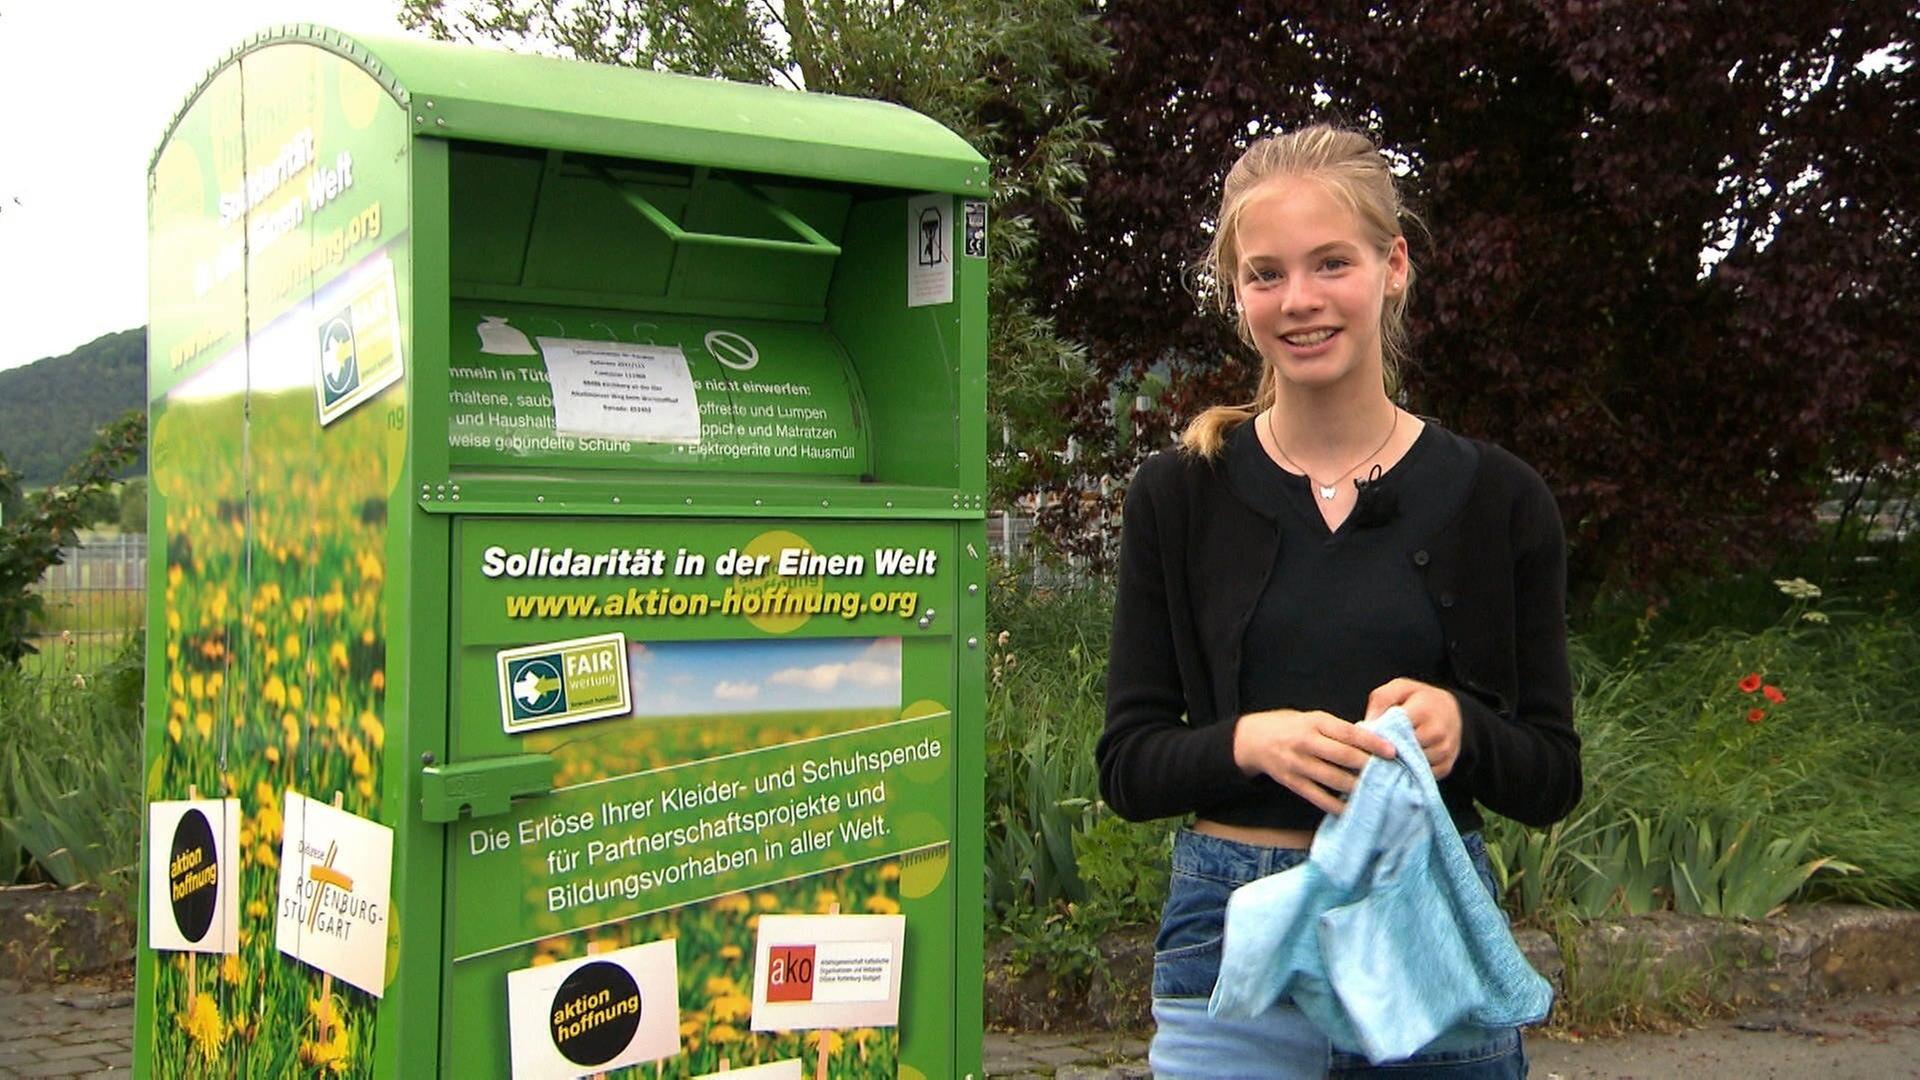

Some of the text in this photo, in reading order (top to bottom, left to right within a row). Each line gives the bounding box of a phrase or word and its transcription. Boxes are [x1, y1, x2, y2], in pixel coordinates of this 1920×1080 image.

[500, 369, 516, 381] in
[705, 379, 740, 391] nicht
[743, 381, 812, 396] einwerfen:
[456, 411, 484, 426] und
[750, 406, 774, 418] und
[777, 406, 827, 421] Lumpen
[579, 437, 632, 453] Schuhe
[749, 425, 773, 438] und
[776, 425, 837, 440] Matratzen
[688, 441, 856, 460] Elektrogeräte und Hausmüll
[482, 546, 666, 577] Solidarität
[674, 548, 706, 577] in
[715, 547, 771, 577] der
[777, 548, 865, 577] Einen
[874, 548, 937, 577] Welt
[506, 586, 918, 619] www.aktion-hoffnung.org
[566, 650, 614, 678] FAIR
[569, 674, 616, 690] wertung
[470, 737, 942, 855] Die Erlöse Ihrer Kleider- und Schuhspende
[547, 781, 886, 875] für Partnerschaftsprojekte und
[171, 847, 203, 879] aktion
[547, 814, 891, 912] Bildungsvorhaben in aller Welt.
[173, 863, 217, 902] hoffnung
[771, 951, 812, 985] ako
[554, 988, 610, 1025] aktion
[558, 994, 639, 1042] hoffnung
